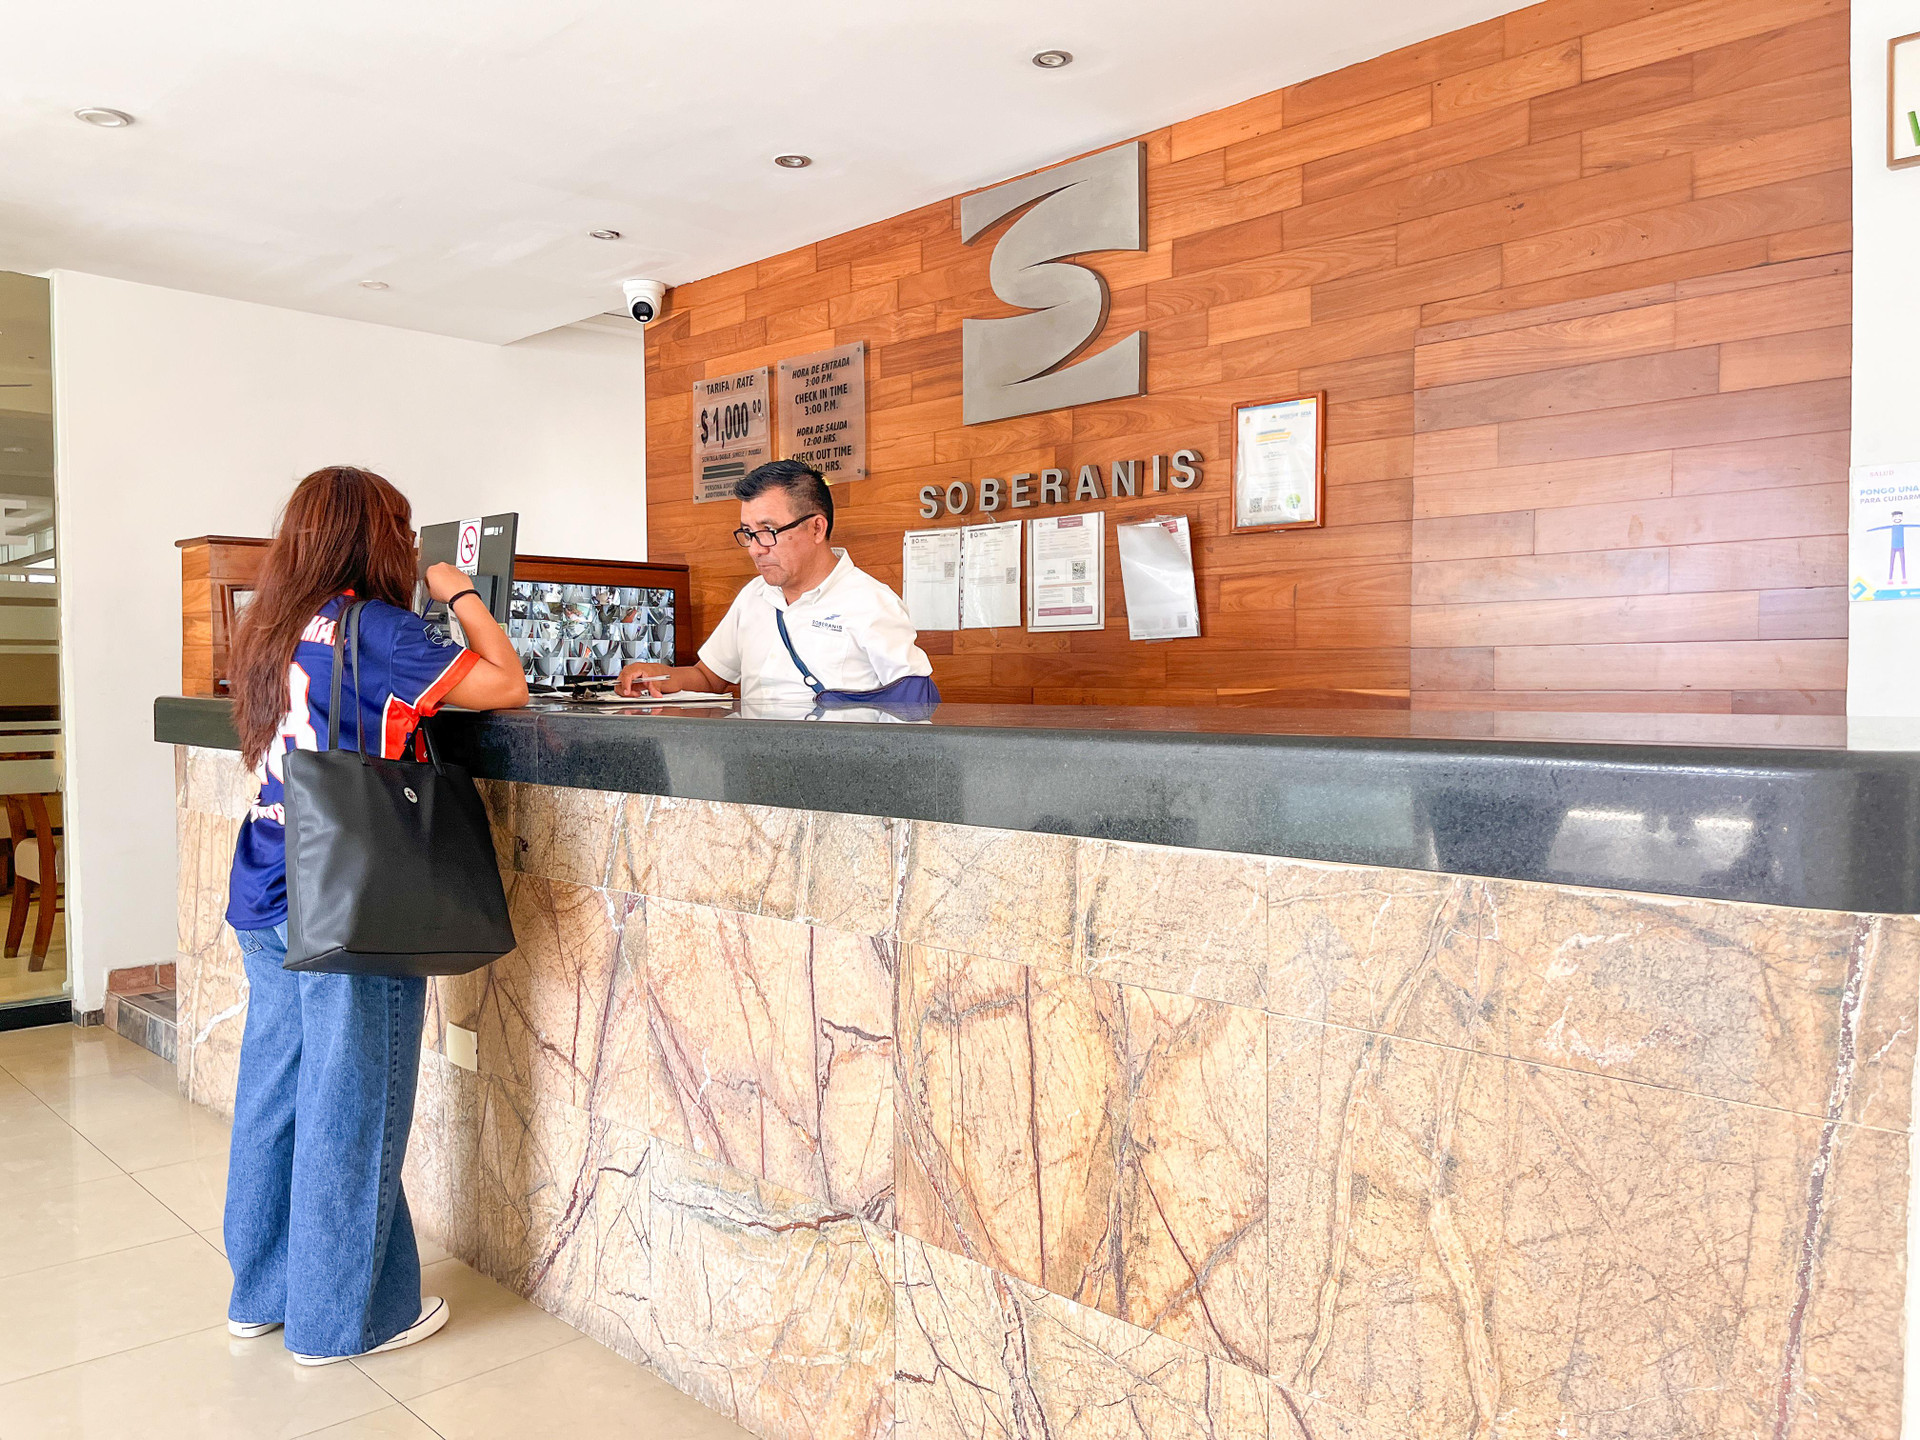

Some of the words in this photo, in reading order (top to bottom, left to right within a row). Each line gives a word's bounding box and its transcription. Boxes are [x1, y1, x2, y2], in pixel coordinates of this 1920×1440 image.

[792, 368, 809, 379] HORA
[811, 365, 820, 375] DE
[821, 357, 850, 372] ENTRADA
[706, 381, 730, 395] TARIFA
[737, 375, 754, 389] RATE
[805, 376, 820, 387] 3:00
[821, 373, 834, 383] P.M.
[795, 391, 817, 405] CHECK
[820, 388, 827, 400] IN
[830, 384, 848, 397] TIME
[804, 403, 822, 416] 3:00
[824, 400, 839, 412] P.M.
[796, 426, 813, 437] HORA
[815, 424, 824, 434] DE
[826, 420, 848, 432] SALIDA
[803, 436, 822, 447] 12:00
[823, 433, 837, 444] HRS.
[792, 451, 814, 463] CHECK
[816, 448, 831, 460] OUT
[833, 445, 852, 458] TIME
[825, 461, 842, 472] HRS.
[919, 449, 1204, 519] SOBERANIS
[1860, 487, 1896, 496] PONGO
[1898, 485, 1919, 493] UNA
